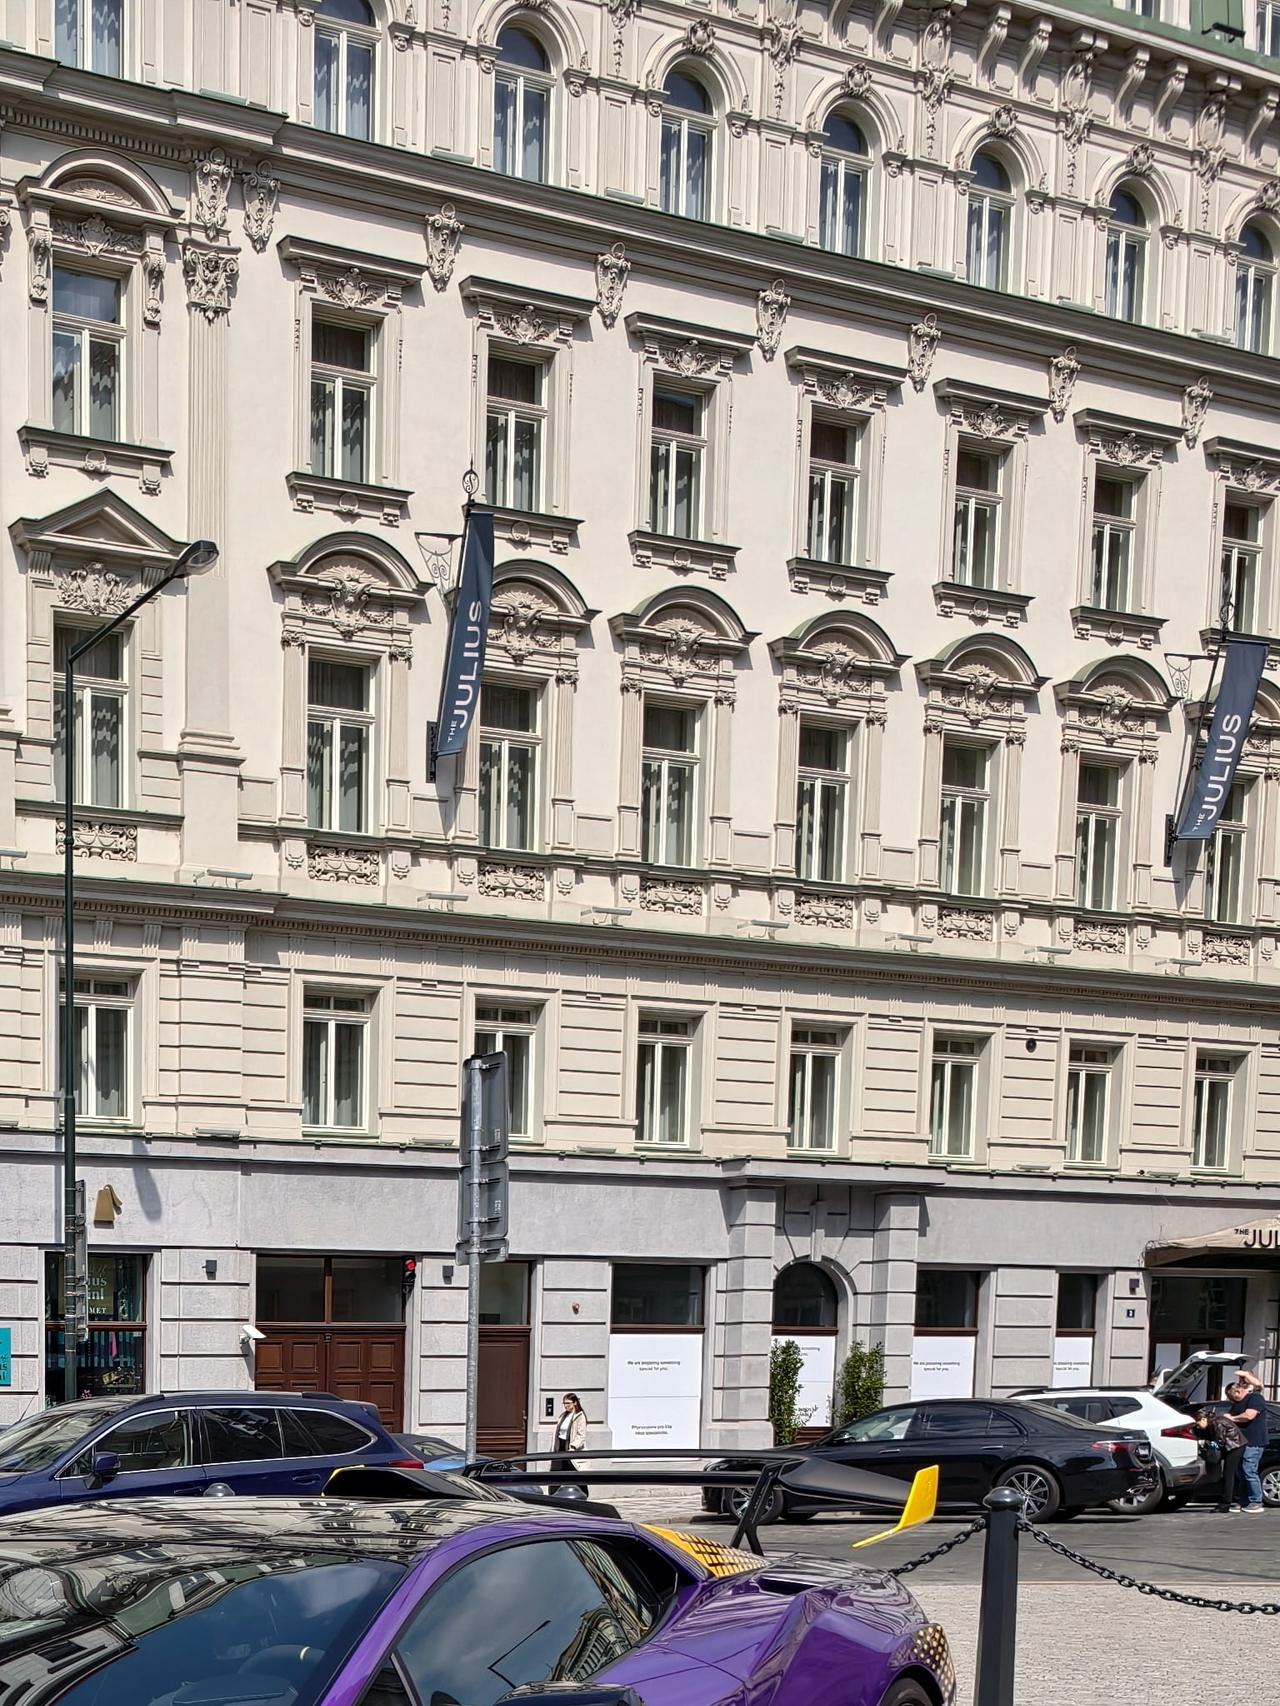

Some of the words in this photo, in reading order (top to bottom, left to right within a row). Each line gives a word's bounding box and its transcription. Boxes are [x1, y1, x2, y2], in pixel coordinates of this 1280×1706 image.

[452, 600, 482, 729] JULIUS
[447, 720, 458, 743] THE
[1191, 812, 1206, 832] THE
[1201, 714, 1242, 820] JULIUS
[1234, 1228, 1249, 1236] THE
